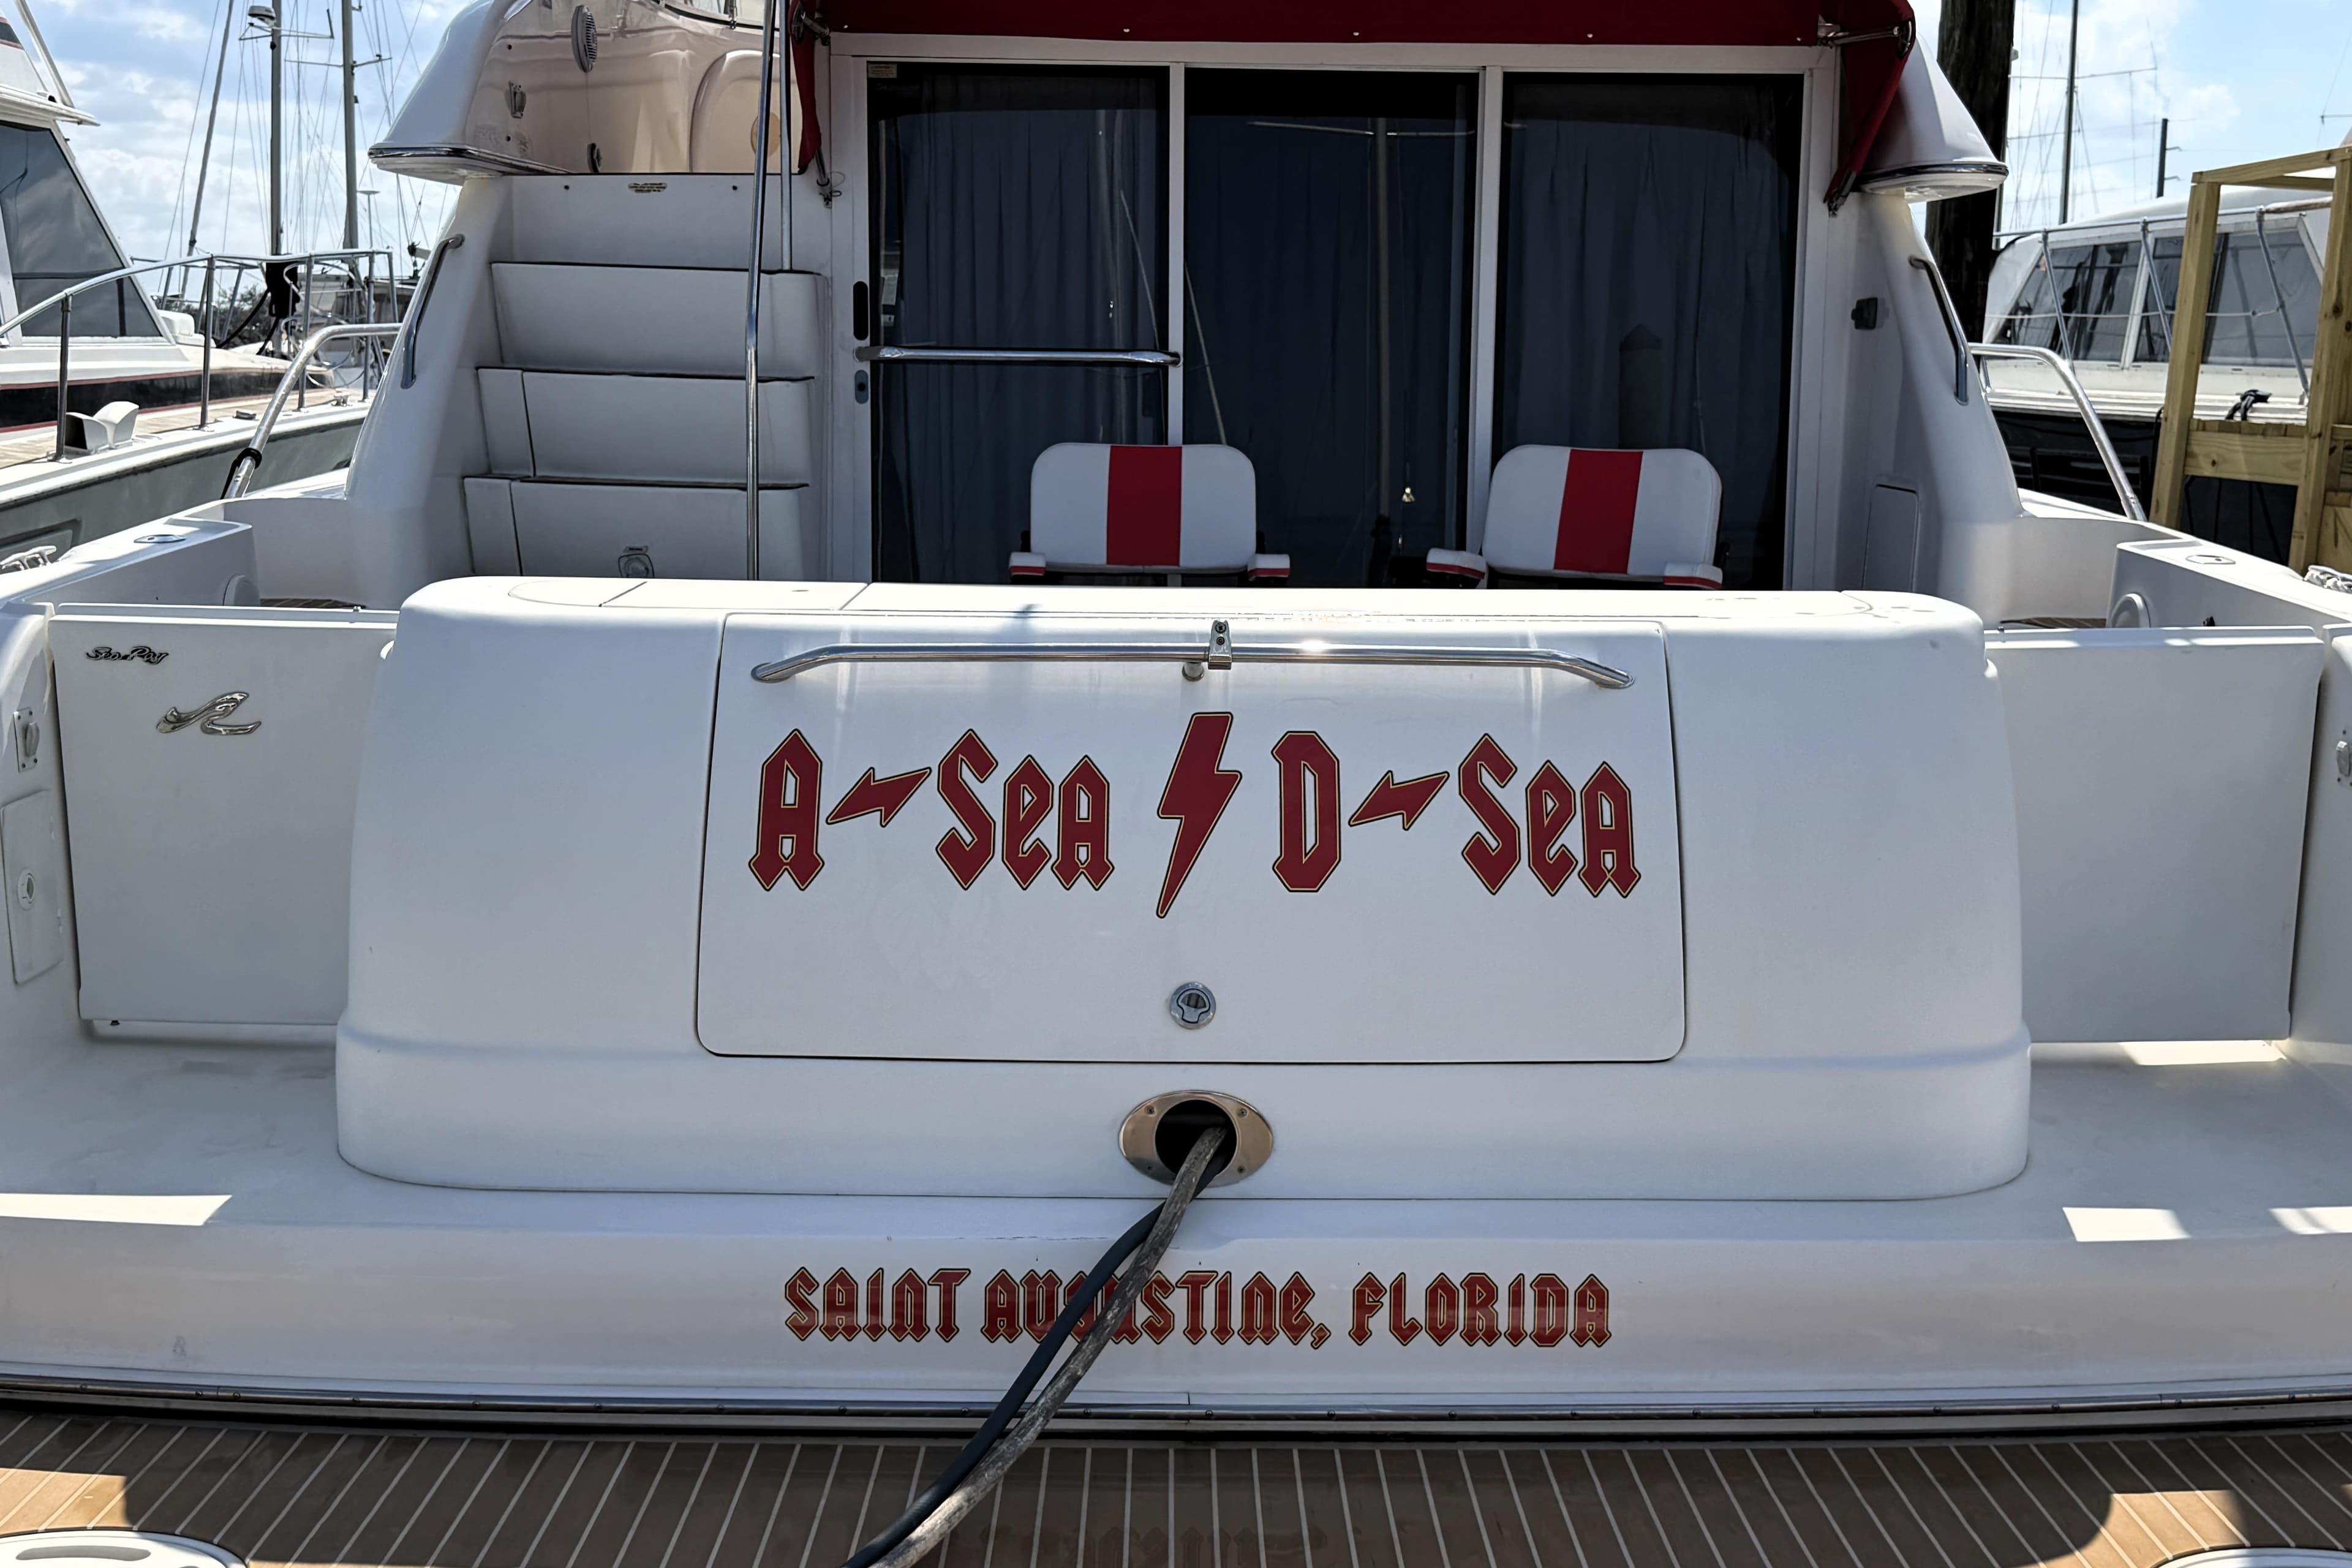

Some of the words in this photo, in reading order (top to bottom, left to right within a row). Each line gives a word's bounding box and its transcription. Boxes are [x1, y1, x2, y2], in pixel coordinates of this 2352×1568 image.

[86, 646, 121, 661] Sea
[127, 646, 169, 665] Ray
[785, 1267, 971, 1343] SAINT
[1349, 1272, 1612, 1347] FLORIDA
